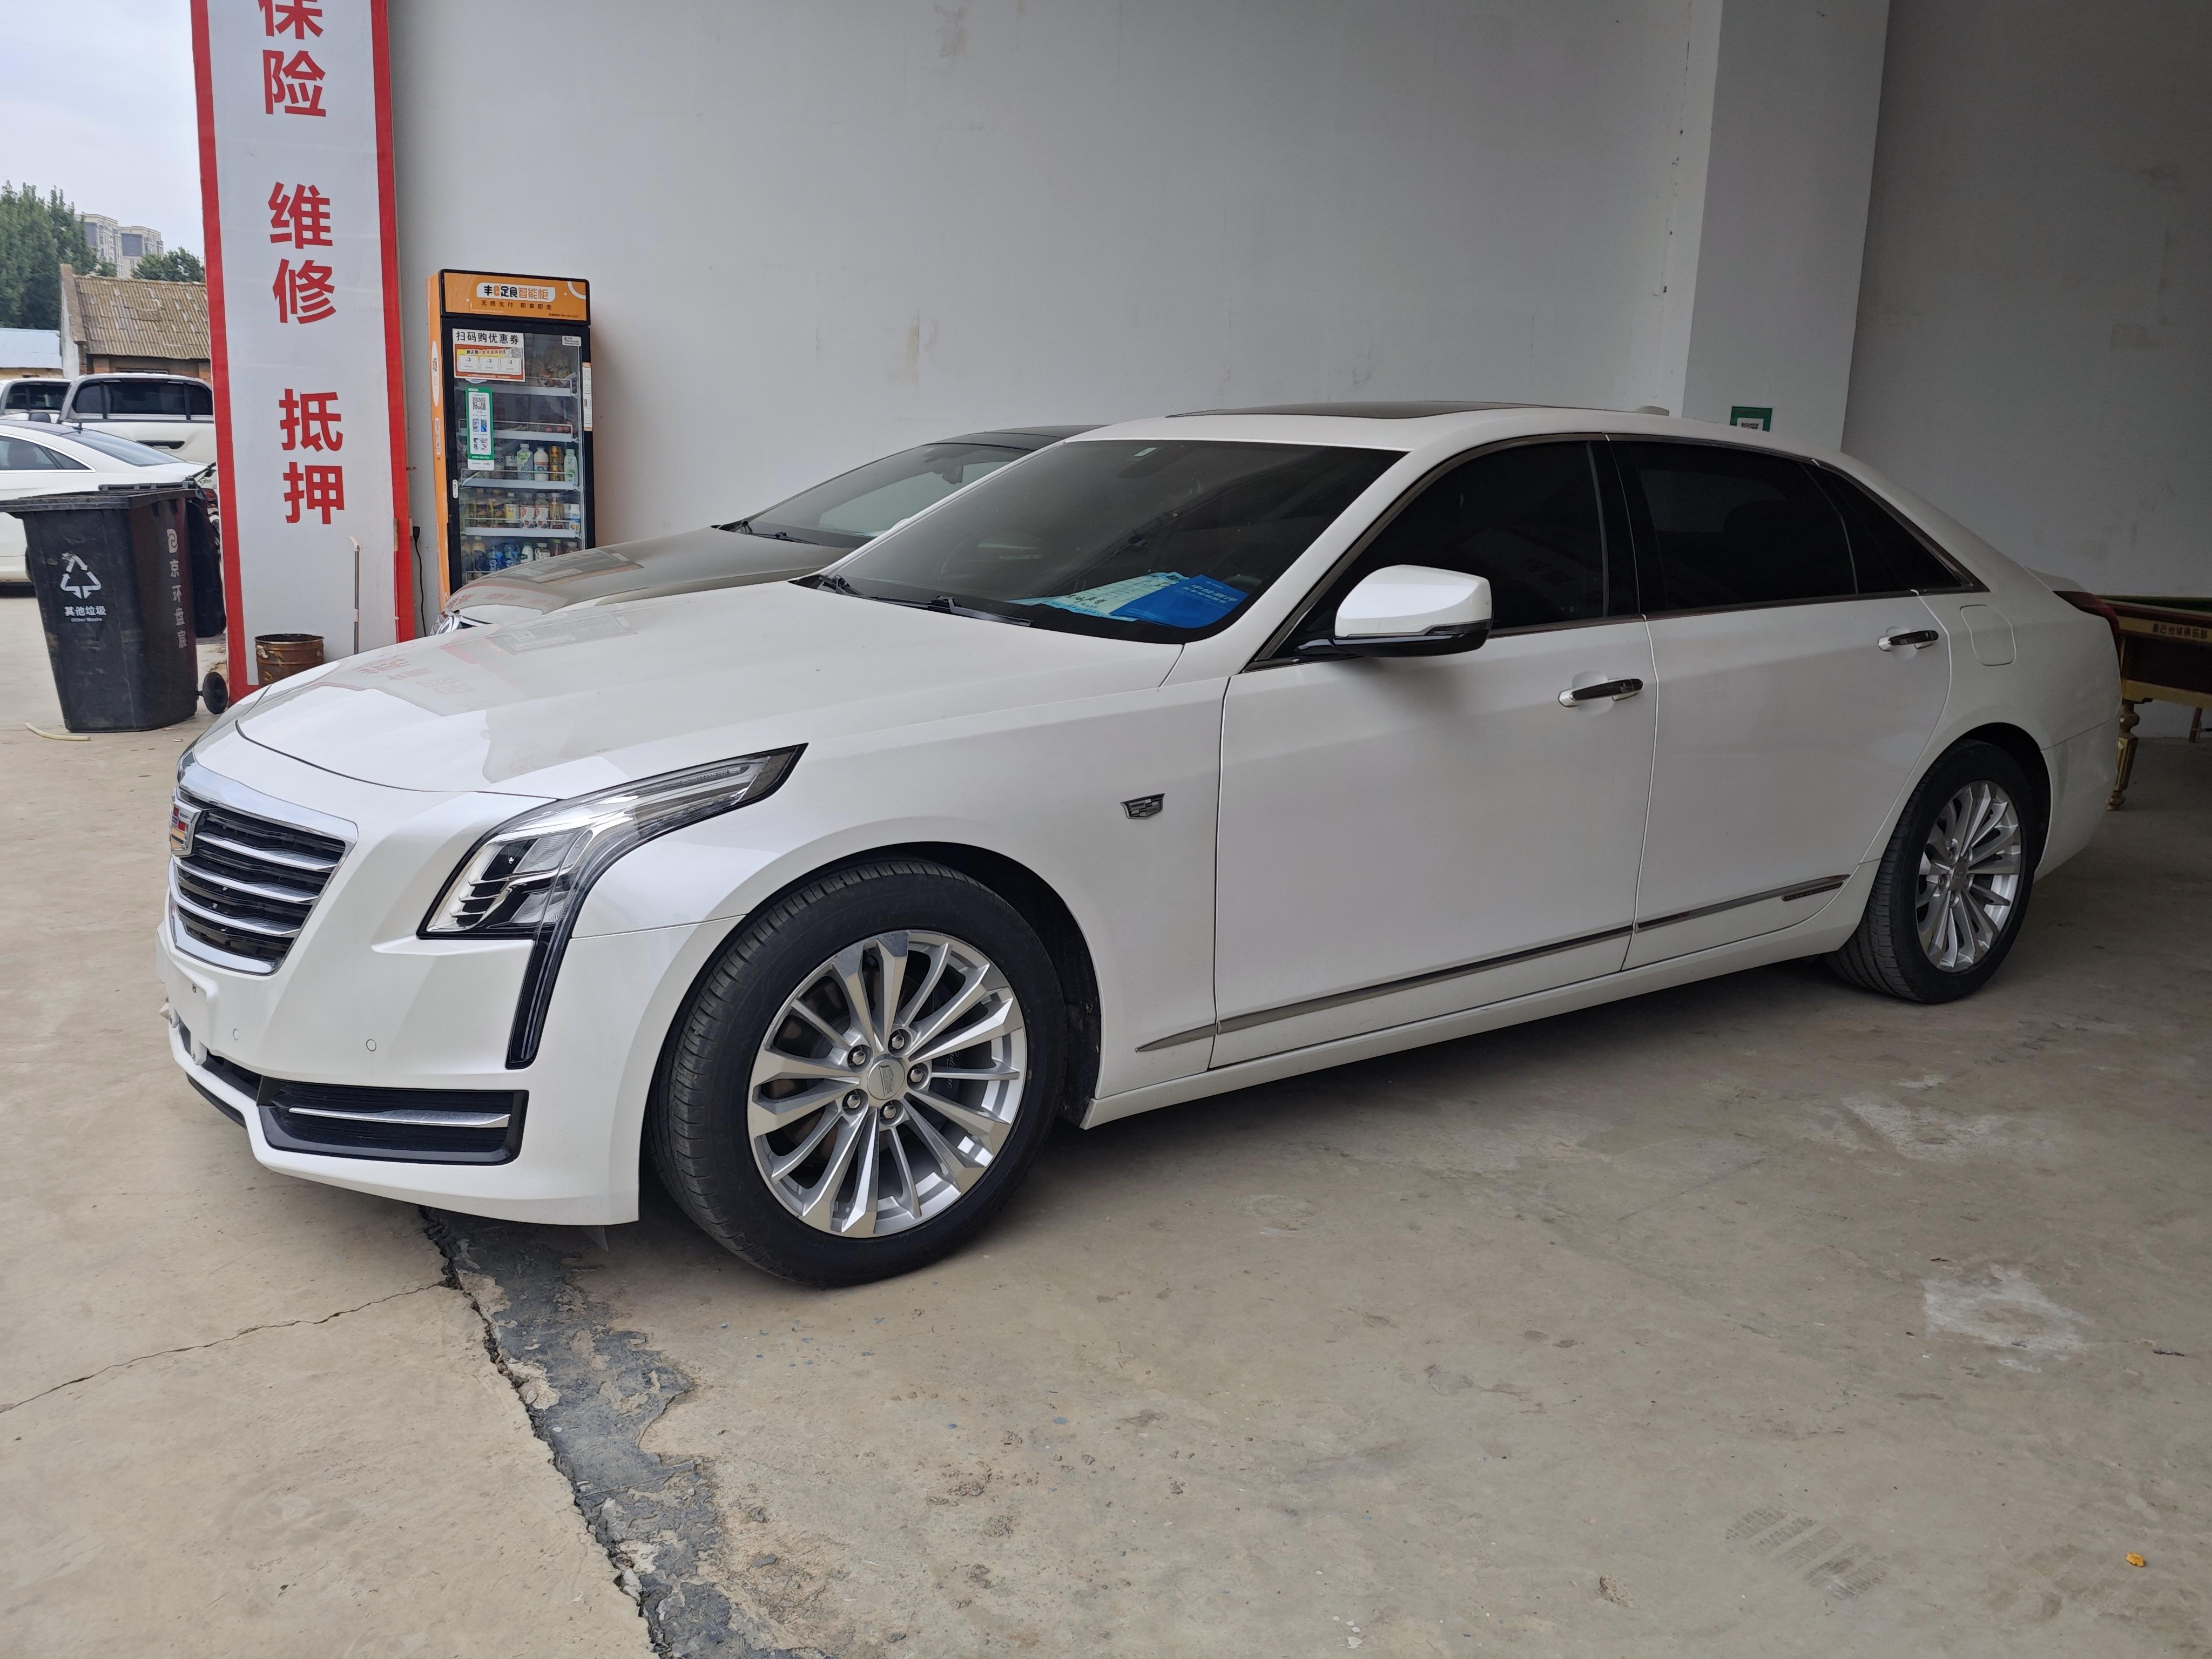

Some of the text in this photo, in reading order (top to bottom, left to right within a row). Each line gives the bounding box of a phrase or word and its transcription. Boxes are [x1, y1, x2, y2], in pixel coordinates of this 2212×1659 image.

[258, 0, 345, 525] 保险 维修 抵押
[481, 300, 514, 308] 无感支付
[456, 331, 519, 345] 扫码购优惠券
[64, 605, 107, 616] 其他垃圾
